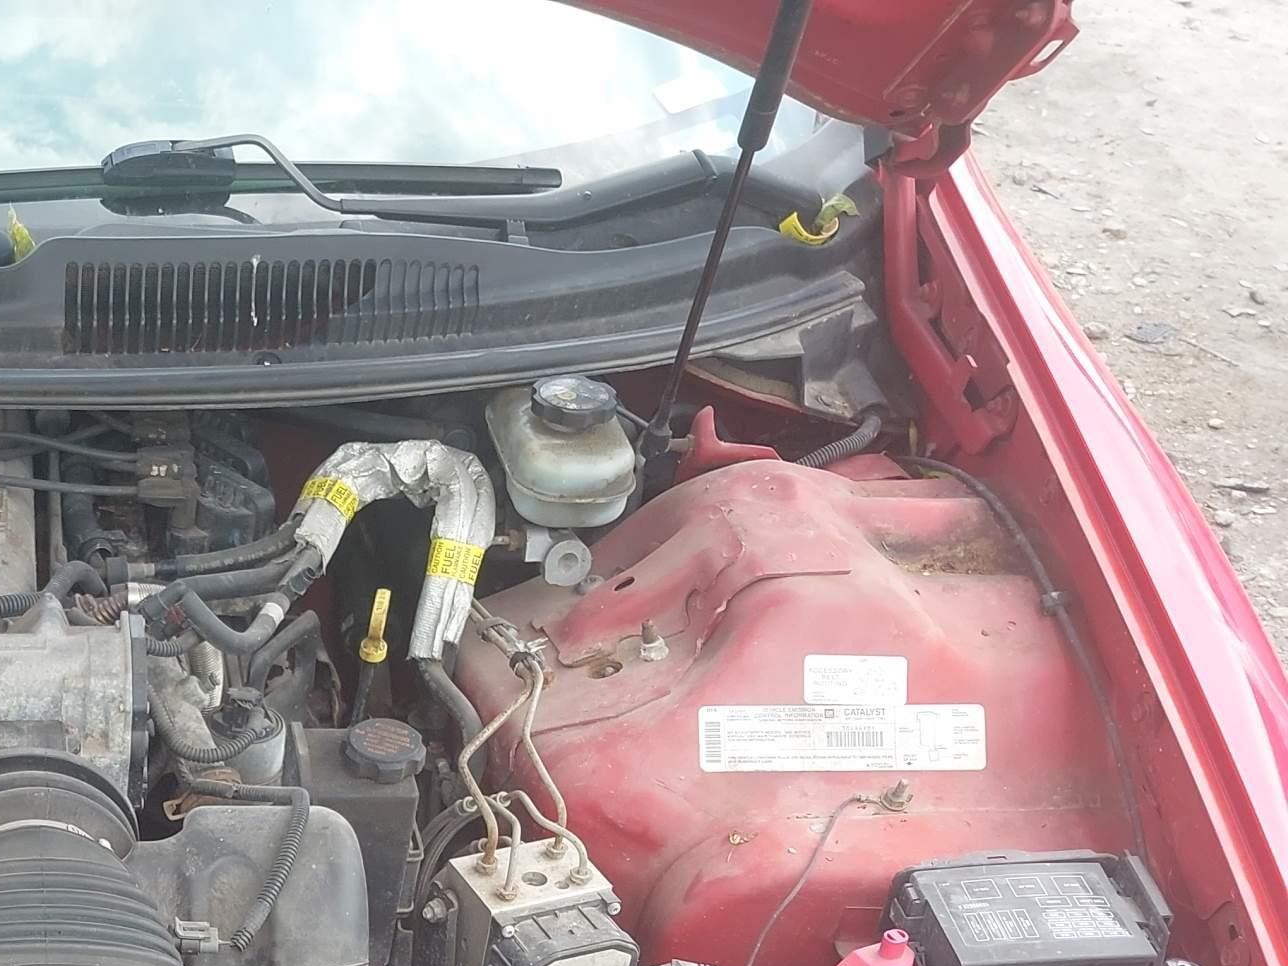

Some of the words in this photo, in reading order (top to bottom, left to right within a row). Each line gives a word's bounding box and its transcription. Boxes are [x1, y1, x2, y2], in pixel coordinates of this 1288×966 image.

[431, 541, 444, 574] CAUTION
[441, 545, 457, 575] FUEL
[460, 547, 471, 579] CAUTION
[468, 551, 481, 581] FUEL
[843, 708, 886, 716] CATALYST
